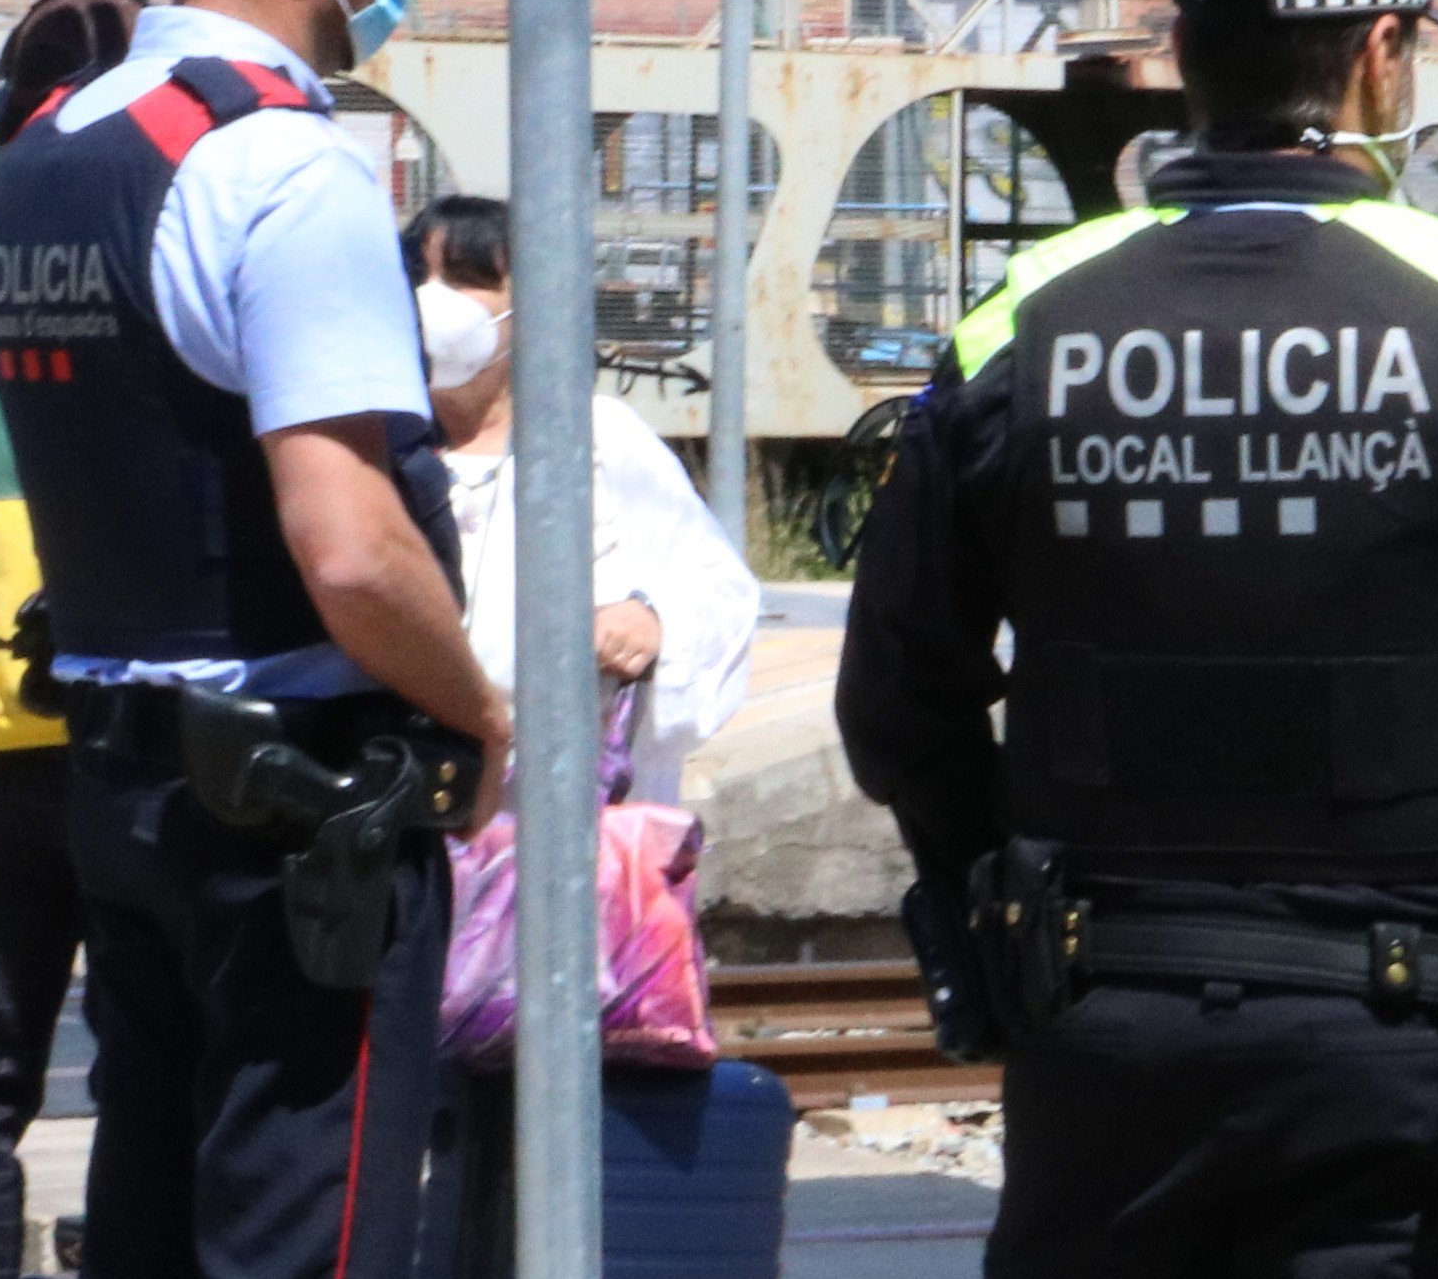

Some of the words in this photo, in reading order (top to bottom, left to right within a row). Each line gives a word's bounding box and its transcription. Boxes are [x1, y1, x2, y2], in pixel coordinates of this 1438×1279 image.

[1048, 326, 1432, 418] POLICIA
[1049, 433, 1212, 484] LOCAL
[1238, 418, 1433, 493] LLANÇÀ
